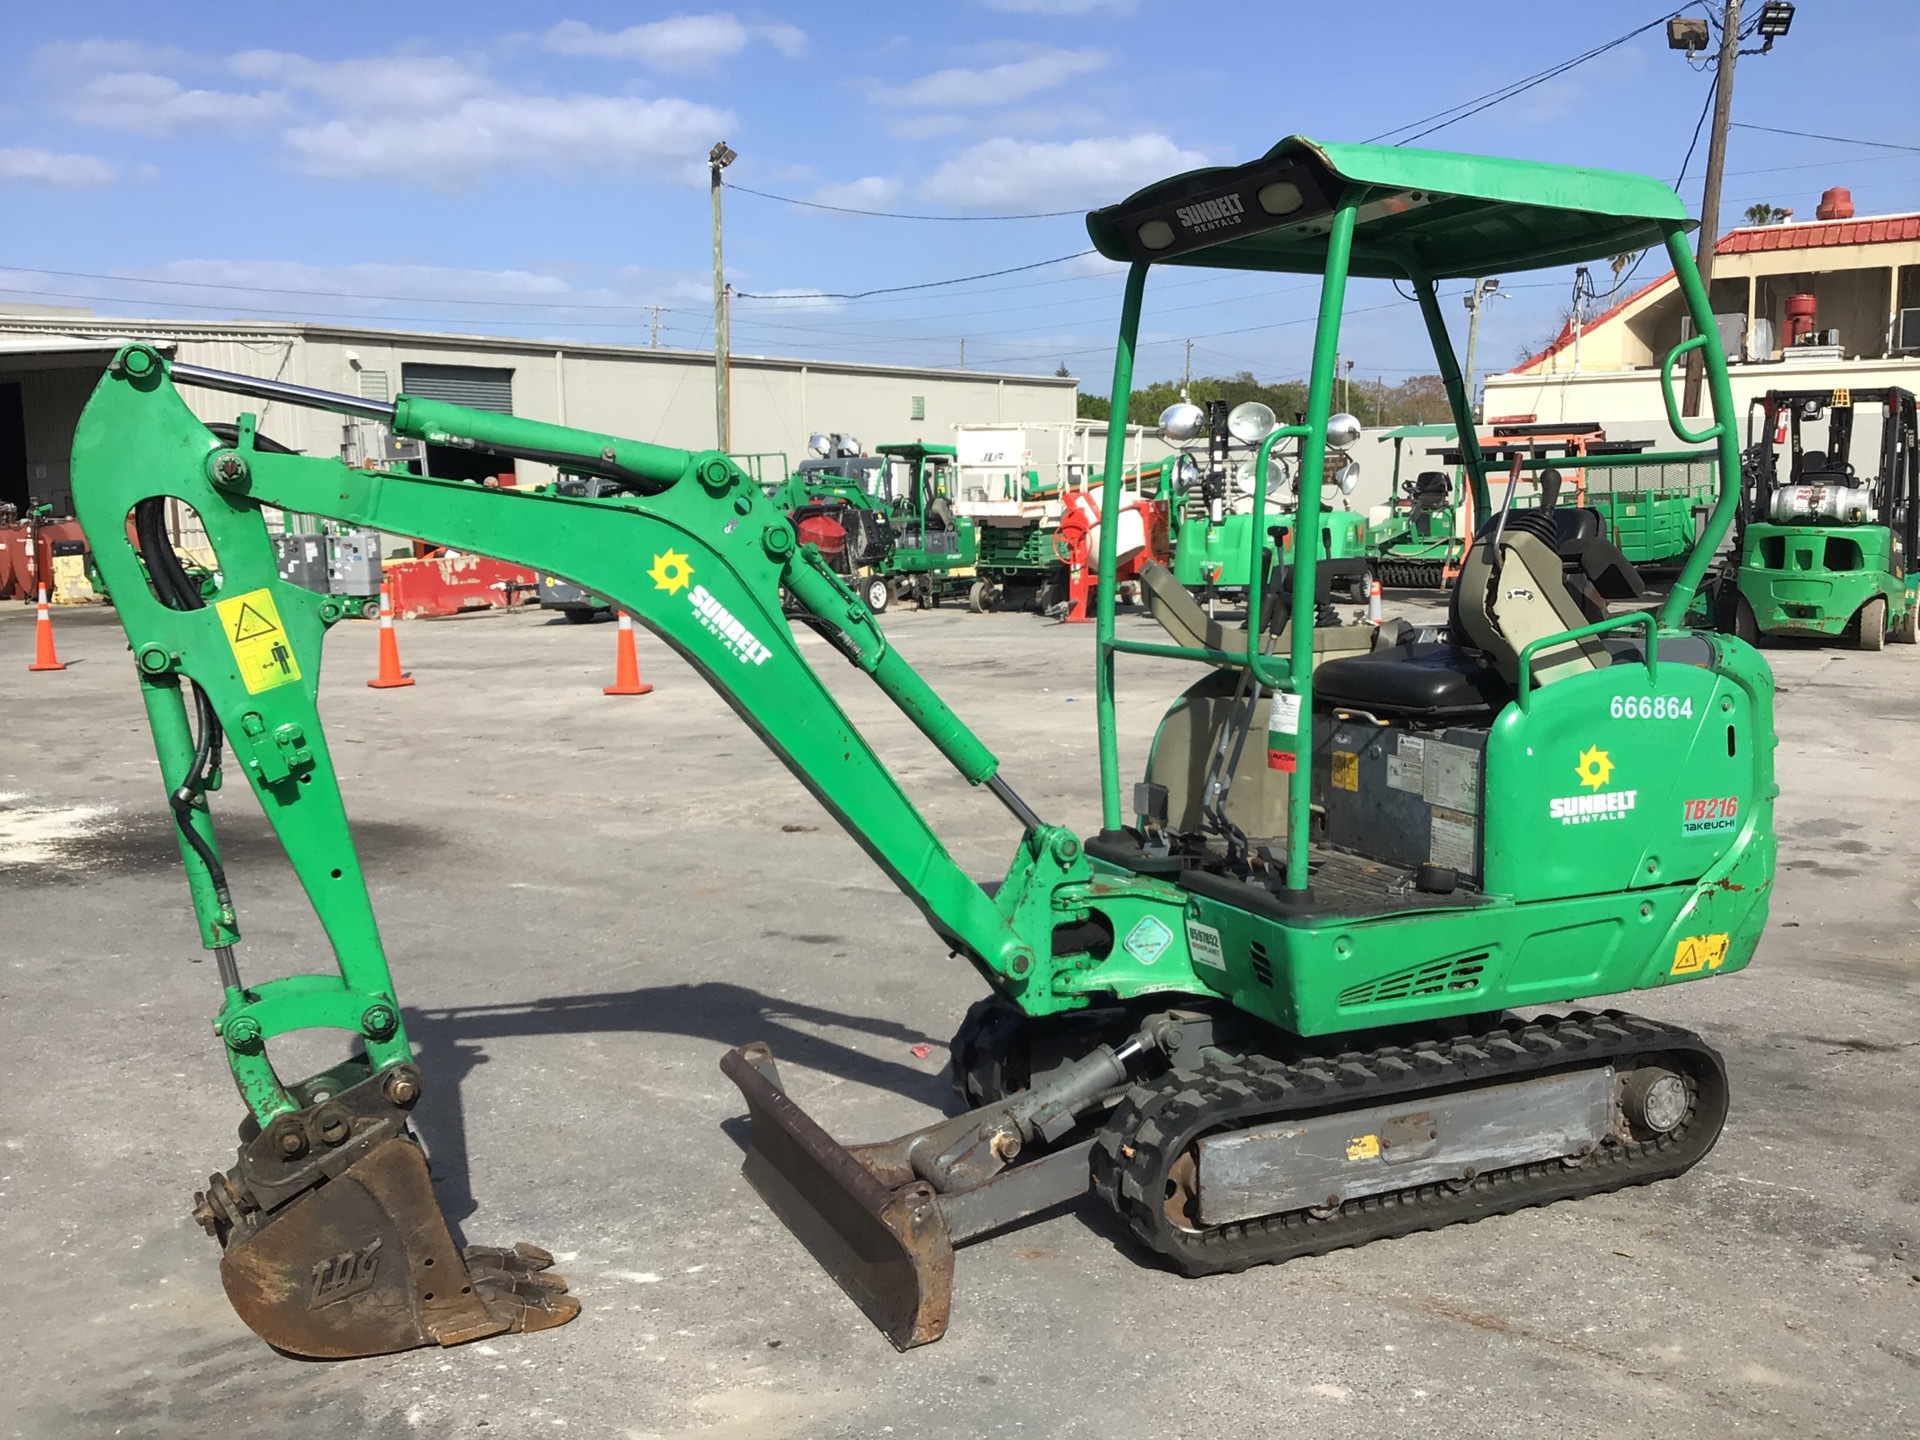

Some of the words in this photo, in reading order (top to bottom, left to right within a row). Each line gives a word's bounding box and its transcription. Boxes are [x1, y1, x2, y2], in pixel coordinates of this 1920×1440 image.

[1176, 193, 1245, 228] SUNBELT
[1193, 214, 1242, 234] RENTALS
[687, 584, 773, 666] SUNBELT
[691, 608, 749, 664] RENTALS
[1610, 695, 1693, 720] 666864
[1550, 790, 1637, 818] SUNBELT
[1684, 797, 1738, 821] TB216
[1562, 811, 1625, 826] RENTALS
